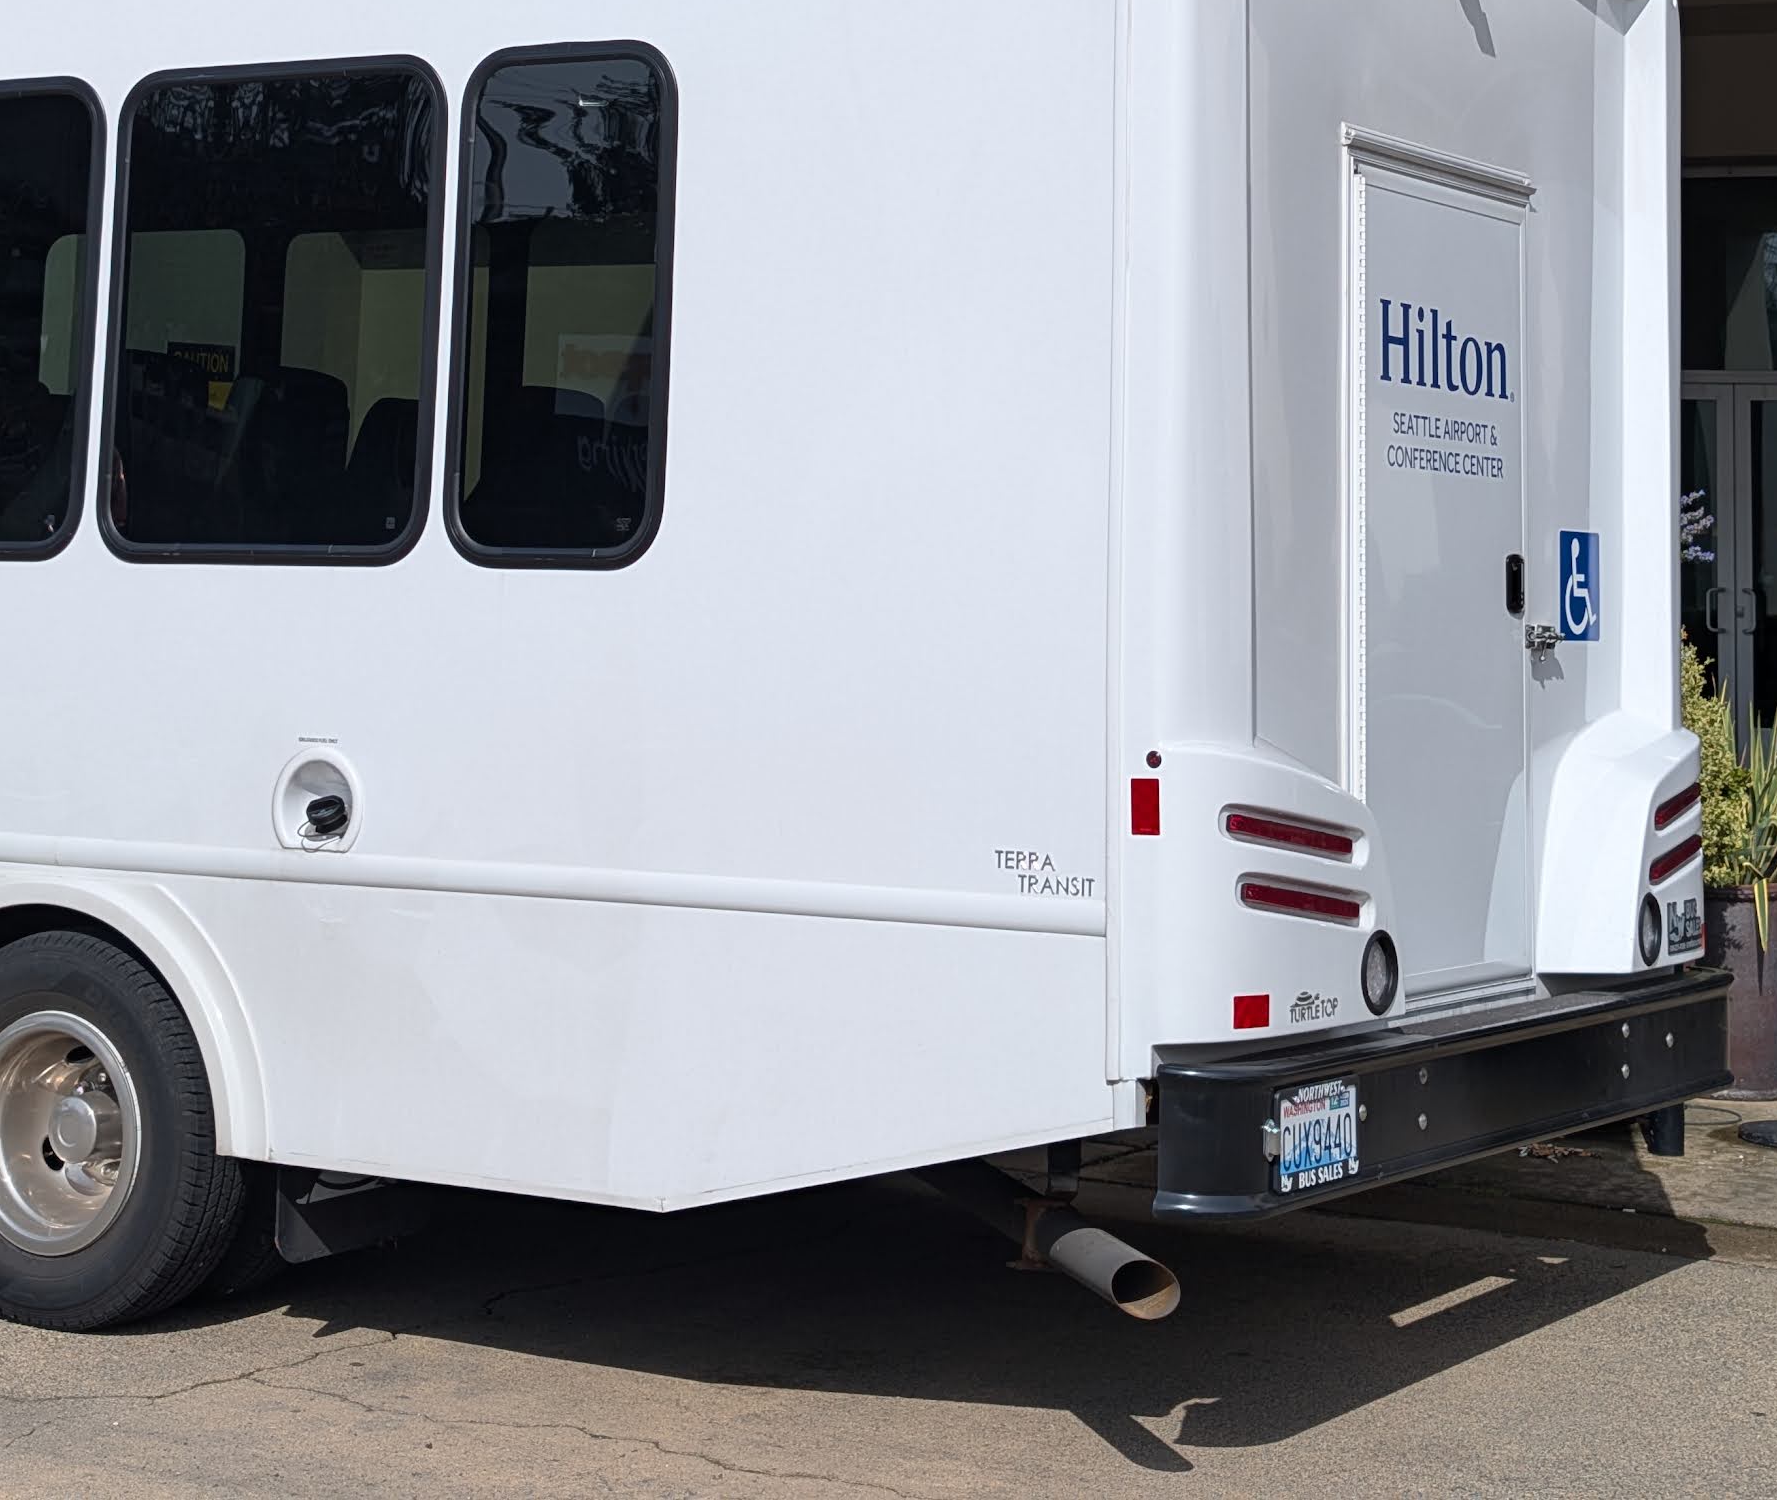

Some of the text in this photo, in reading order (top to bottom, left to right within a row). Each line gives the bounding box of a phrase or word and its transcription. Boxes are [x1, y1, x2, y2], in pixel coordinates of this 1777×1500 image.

[1392, 411, 1498, 446] SEATTLE AIRPORT &
[1387, 444, 1504, 480] CONFERENCE CENTER
[994, 849, 1056, 872] TERRA
[1017, 874, 1096, 897] TRANSIT
[1297, 1080, 1343, 1102] NORTHWEST
[1283, 1098, 1326, 1119] WASHINGTON
[1282, 1112, 1353, 1172] CUX9440
[1298, 1162, 1343, 1189] BUS SALES
